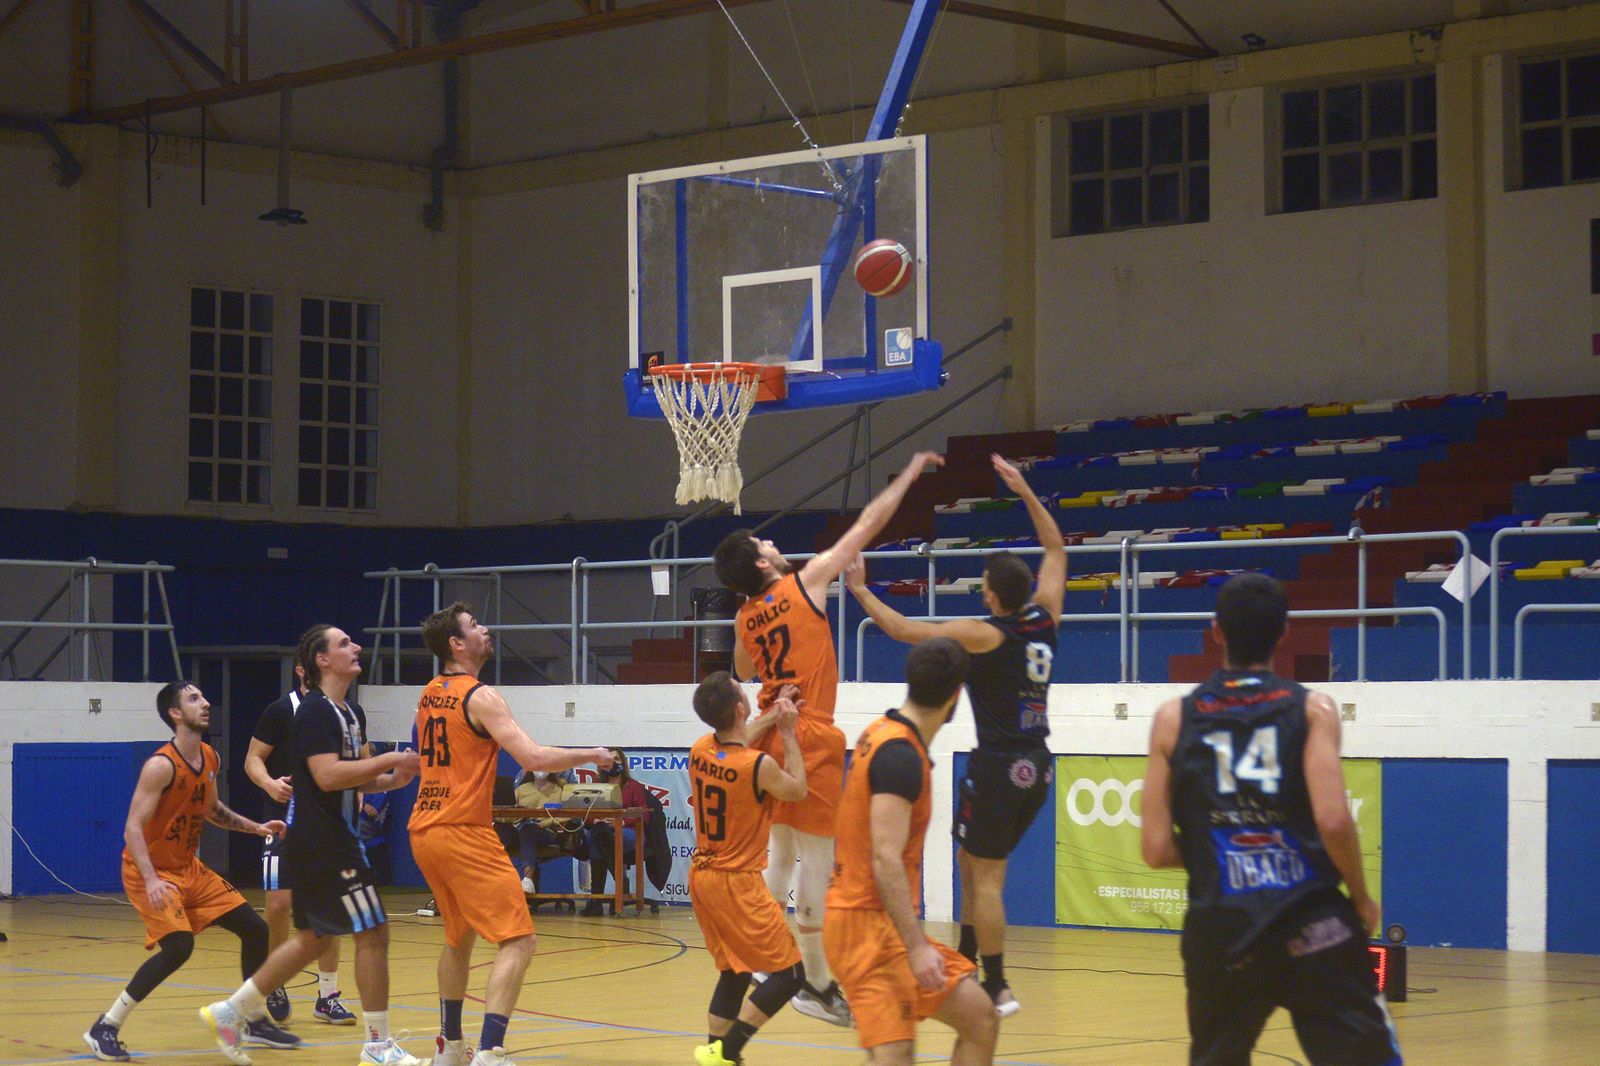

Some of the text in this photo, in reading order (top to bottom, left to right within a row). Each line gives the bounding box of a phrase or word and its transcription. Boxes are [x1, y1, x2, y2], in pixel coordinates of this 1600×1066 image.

[889, 352, 906, 361] EBA
[746, 599, 791, 631] ORLIC
[755, 624, 796, 679] 12
[1026, 642, 1053, 683] 8
[421, 716, 451, 767] 43
[690, 757, 738, 783] MARIO
[1202, 726, 1280, 794] 14
[695, 777, 727, 841] 13
[1098, 885, 1180, 900] ESPECIALISTAS
[1153, 902, 1172, 914] 172
